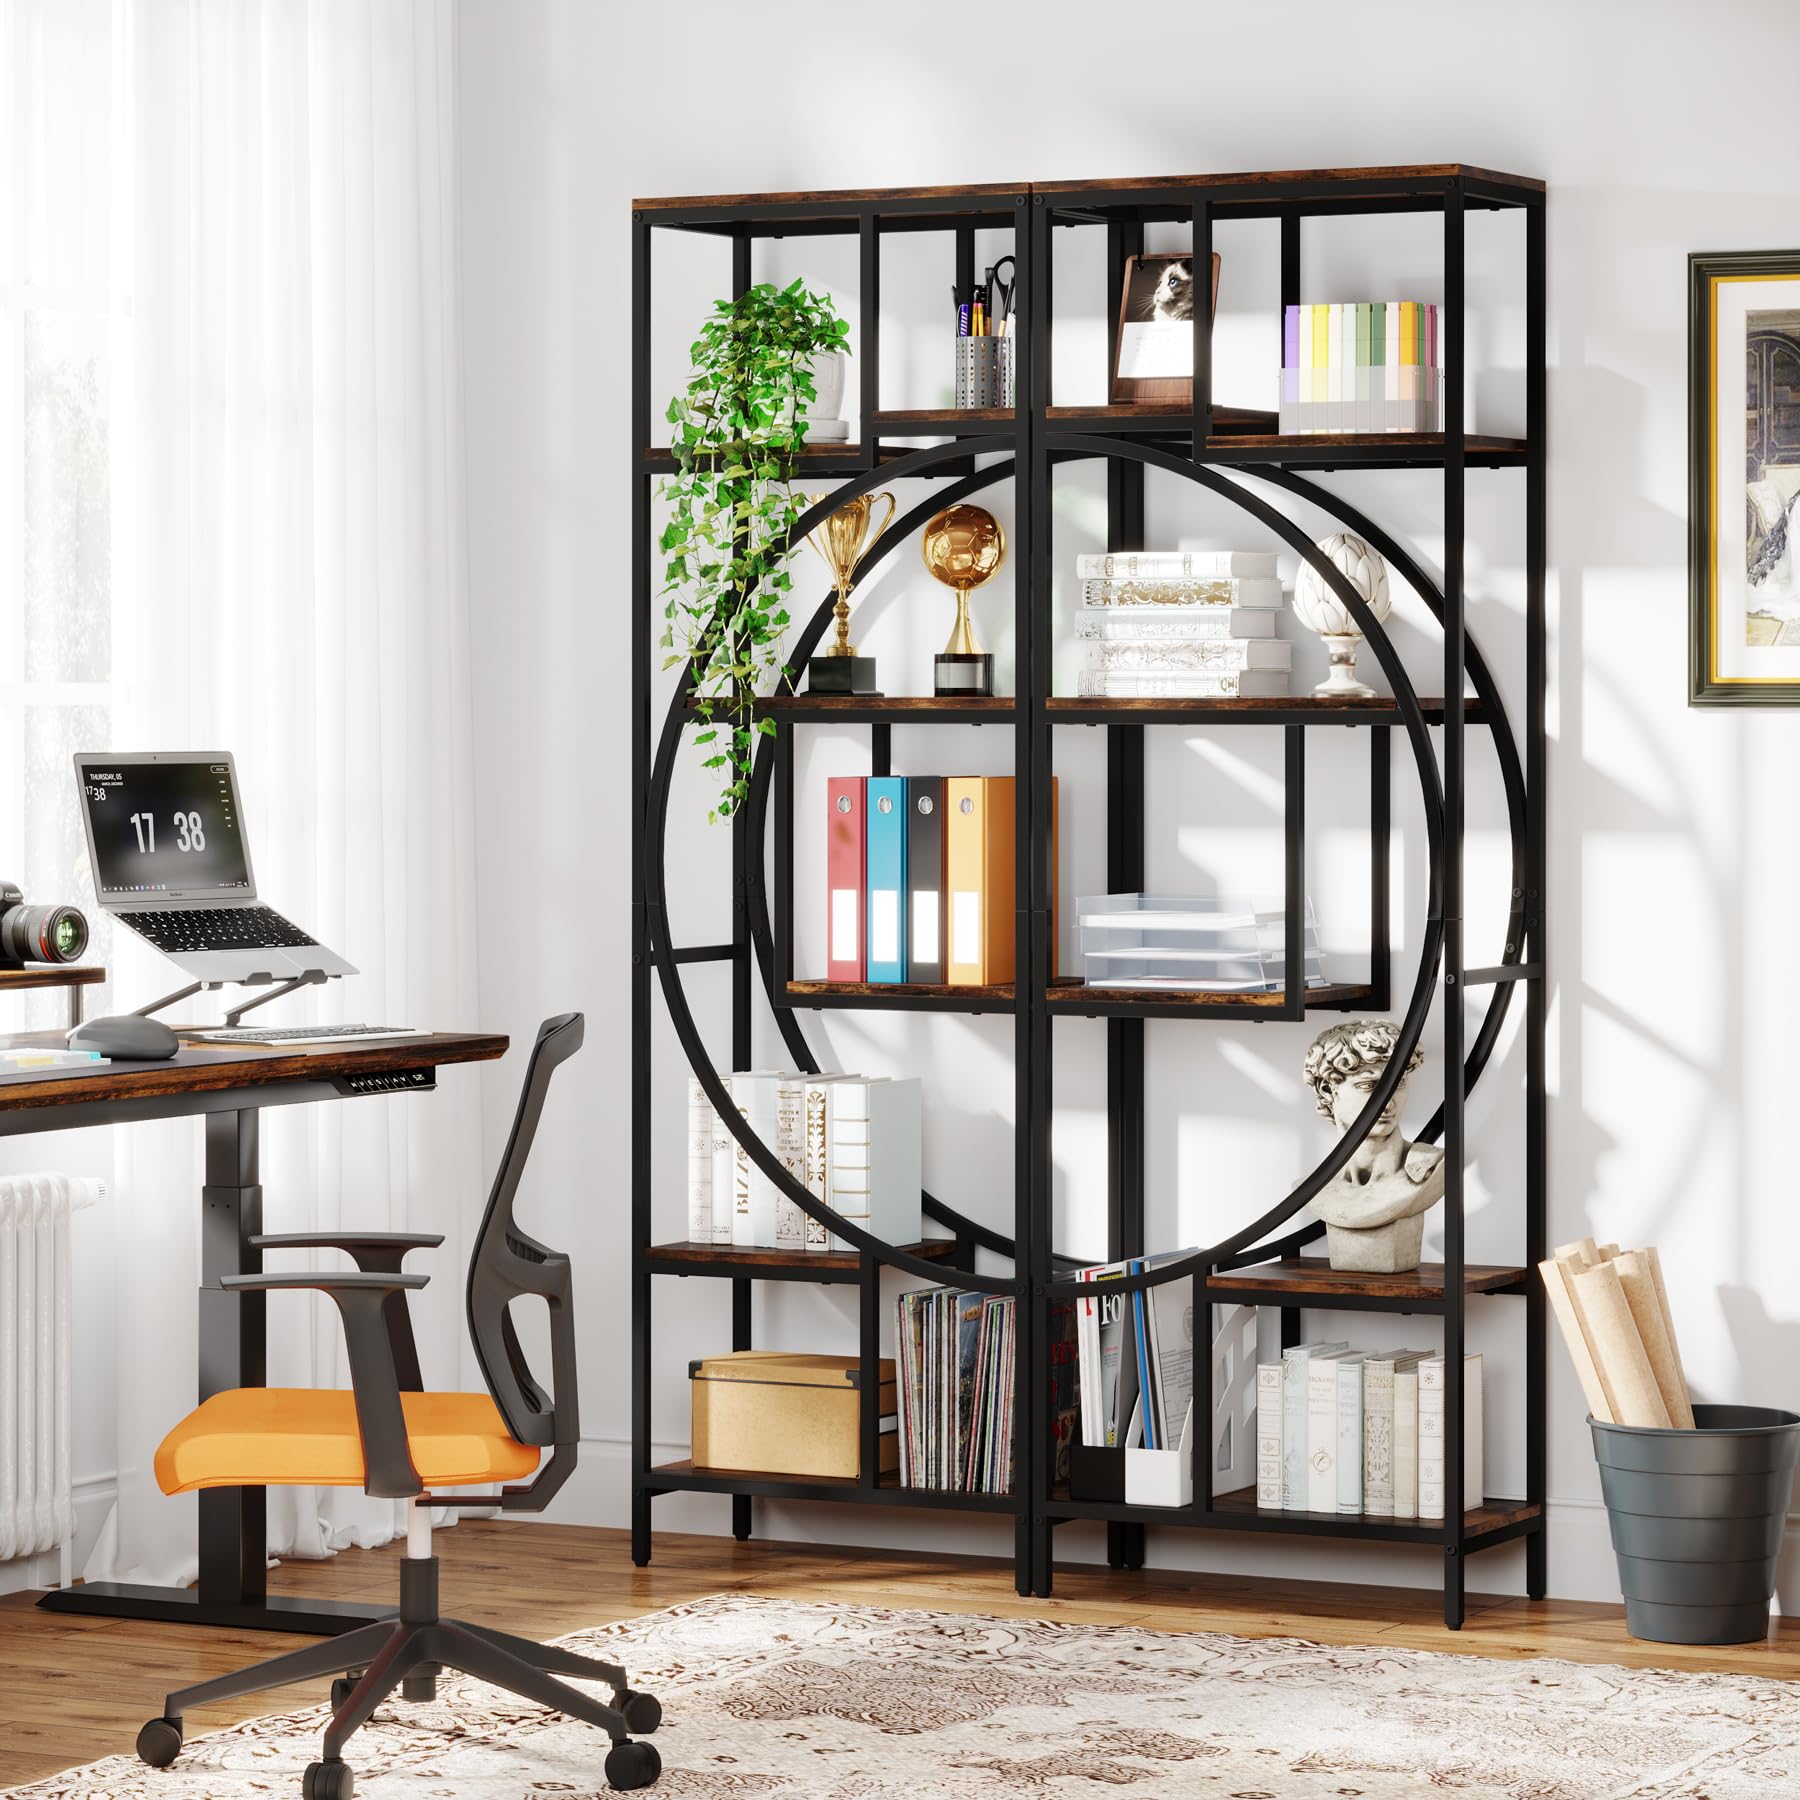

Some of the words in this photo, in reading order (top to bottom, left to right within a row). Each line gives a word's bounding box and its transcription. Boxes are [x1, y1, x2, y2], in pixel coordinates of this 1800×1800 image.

[85, 786, 93, 795] 17
[94, 788, 106, 801] 38
[130, 812, 155, 853] 17
[173, 811, 206, 853] 38
